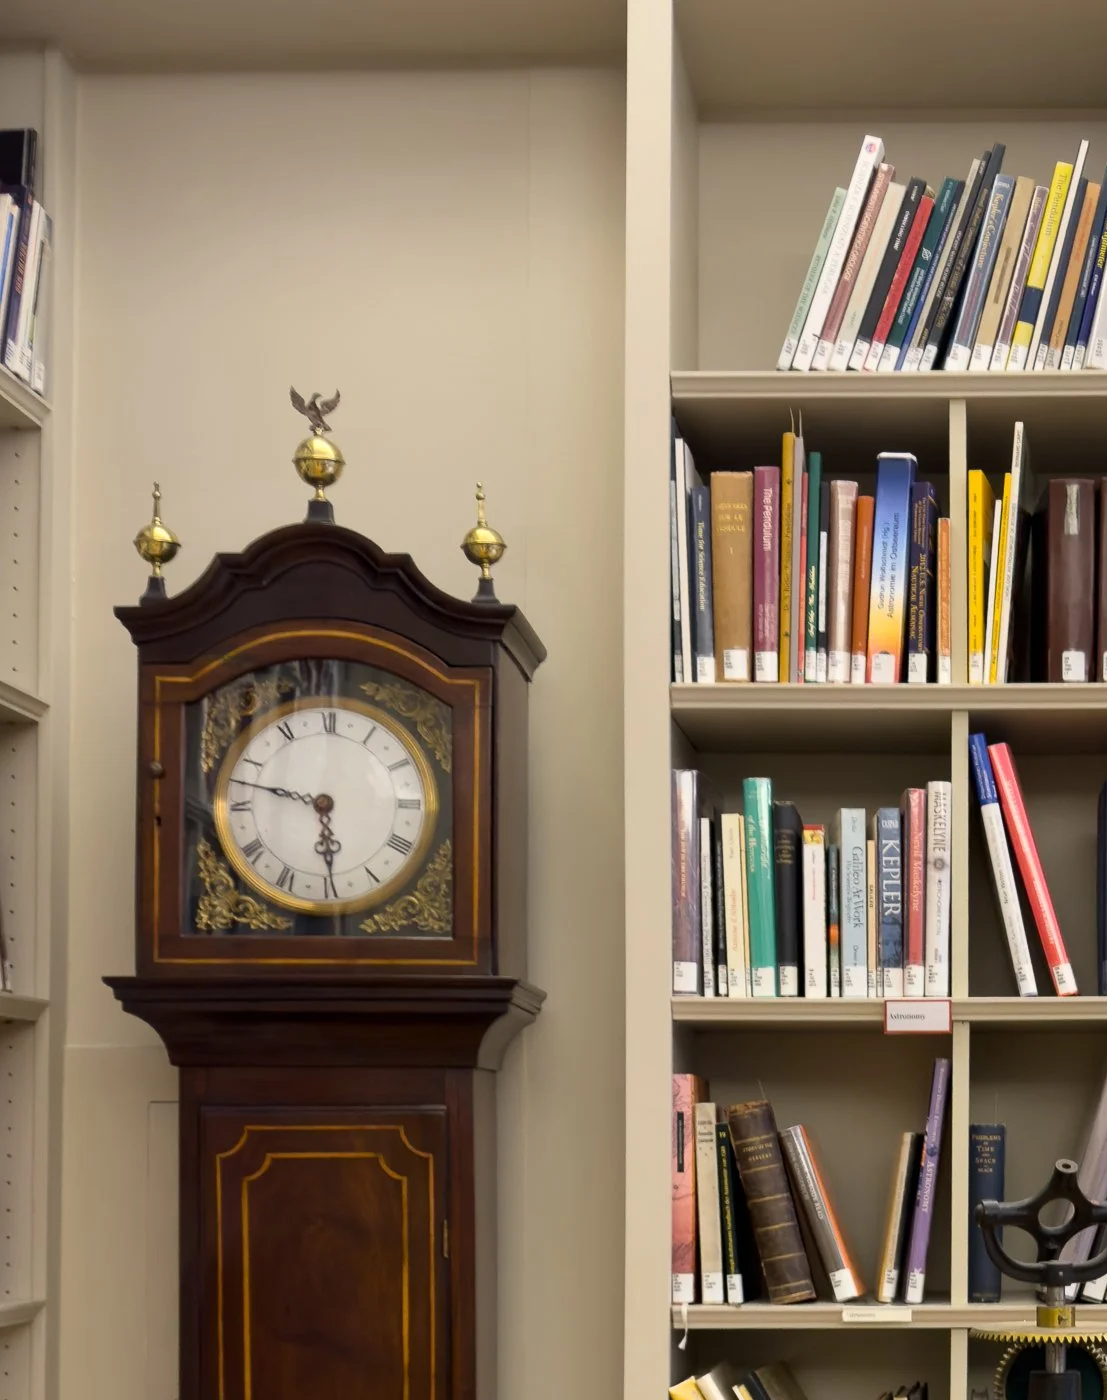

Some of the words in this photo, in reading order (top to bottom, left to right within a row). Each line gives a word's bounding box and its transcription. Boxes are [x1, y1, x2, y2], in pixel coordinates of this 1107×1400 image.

[1055, 173, 1066, 190] The
[1043, 191, 1063, 237] Pendulum
[763, 487, 772, 503] The
[762, 505, 772, 550] Pendulum
[889, 562, 896, 571] im
[910, 565, 918, 601] NAUTICAL
[886, 573, 896, 617] Astronomie
[908, 604, 916, 639] ALMANAC
[932, 791, 946, 852] MASKELYNE
[912, 831, 922, 856] Nevil
[881, 839, 901, 915] KEPLER
[910, 860, 921, 911] Maskelyne
[888, 1012, 925, 1020] Astronomy
[920, 1160, 934, 1213] ASTRONOMY
